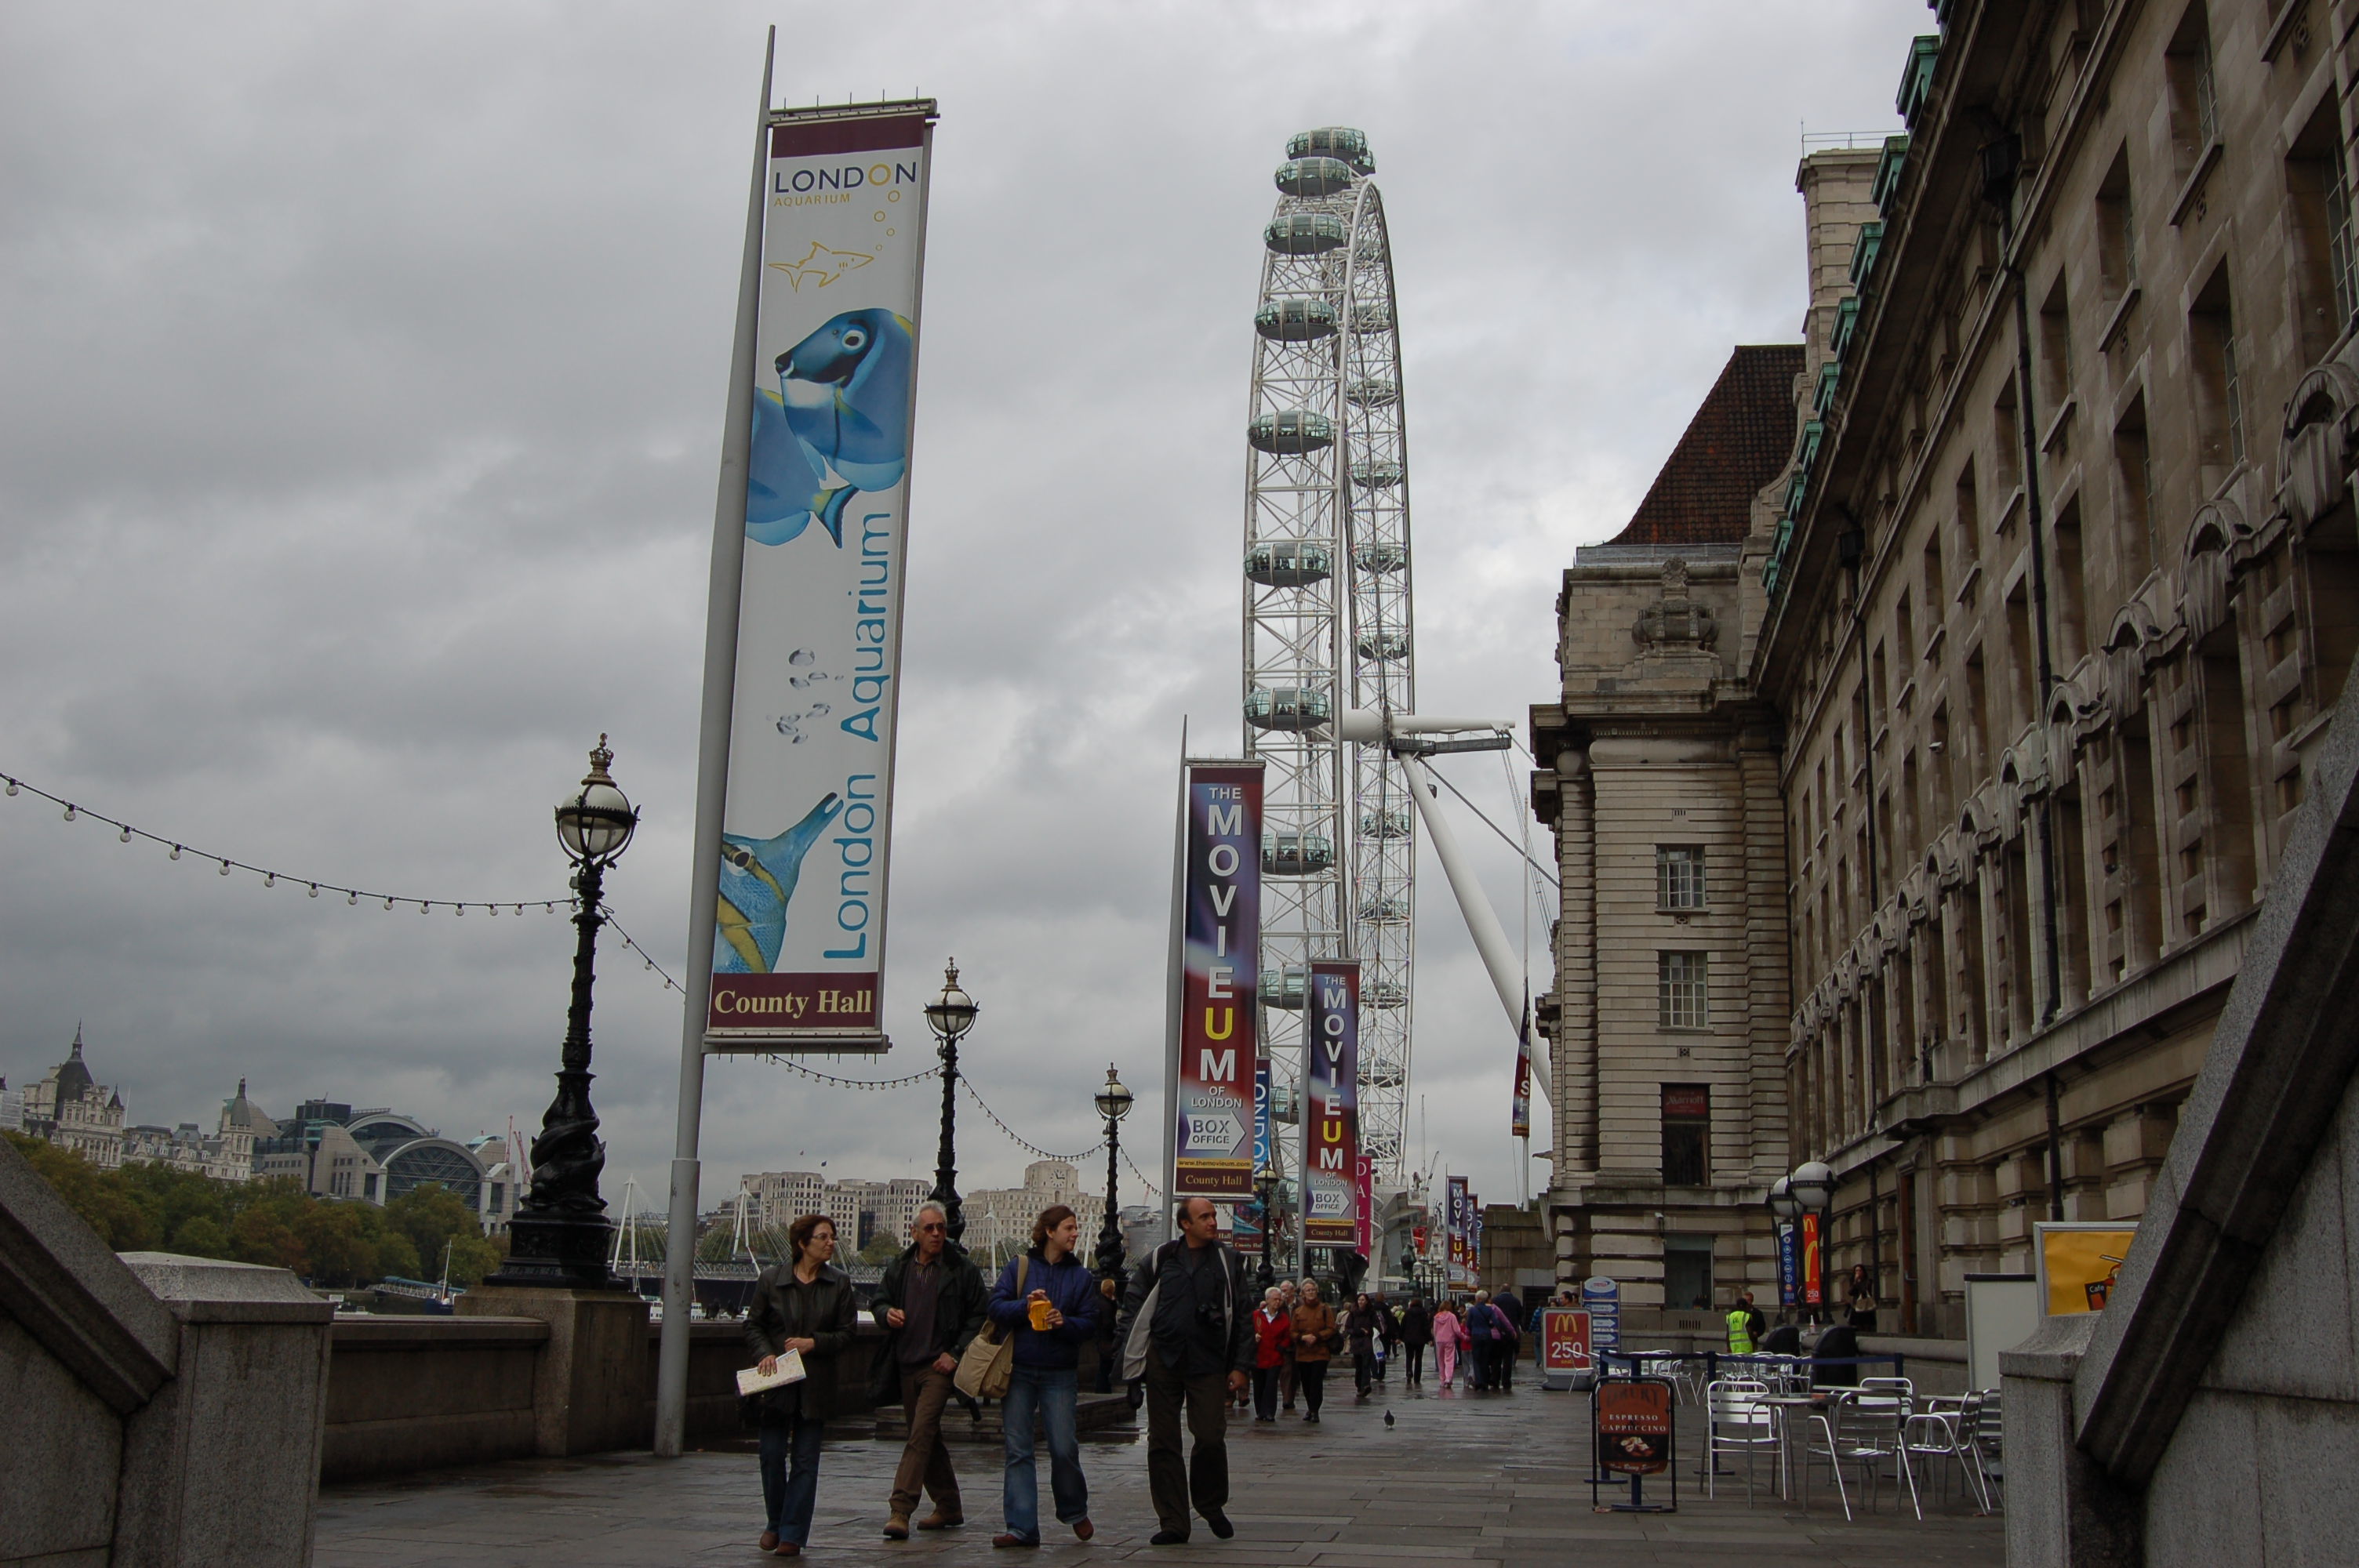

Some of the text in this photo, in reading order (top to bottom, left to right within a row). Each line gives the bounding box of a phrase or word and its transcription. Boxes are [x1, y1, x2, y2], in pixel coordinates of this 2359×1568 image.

[775, 162, 917, 193] LONDON
[774, 193, 851, 207] AQUARIUM
[823, 513, 891, 959] London Aquarium
[1209, 787, 1241, 800] THE
[1200, 804, 1242, 1082] MOVIEUM
[1324, 977, 1346, 985] THE
[714, 990, 871, 1018] County Hall
[1320, 988, 1347, 1169] MOVIEUM
[1209, 1086, 1225, 1096] OF
[1191, 1098, 1242, 1108] LONDON
[1193, 1120, 1230, 1134] BOX
[1192, 1135, 1230, 1144] OFFICE
[1186, 1174, 1242, 1186] County Hall
[1315, 1193, 1339, 1203] BOX
[1453, 1189, 1463, 1262] MOVIEUM
[1552, 1341, 1582, 1359] 250
